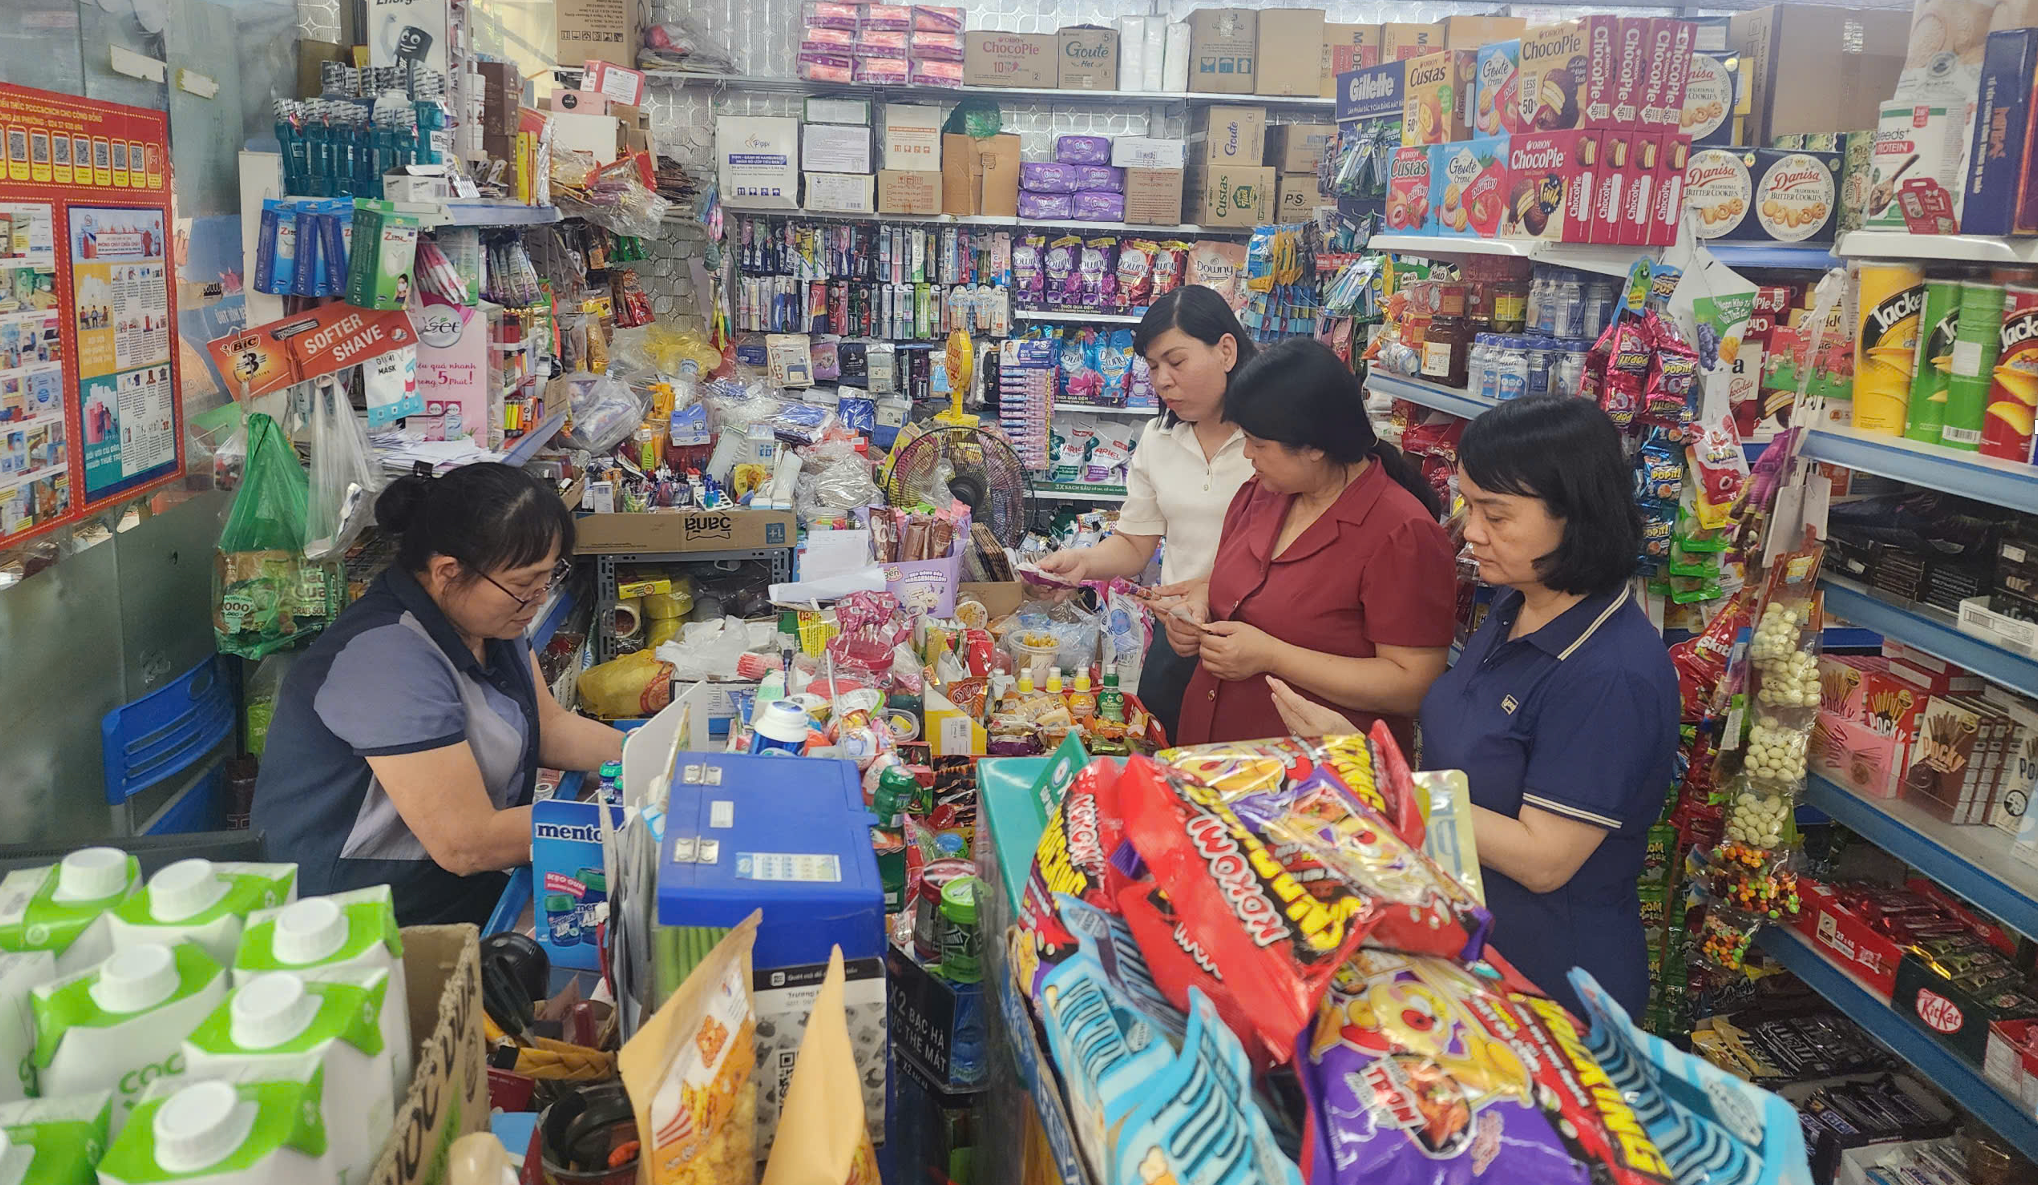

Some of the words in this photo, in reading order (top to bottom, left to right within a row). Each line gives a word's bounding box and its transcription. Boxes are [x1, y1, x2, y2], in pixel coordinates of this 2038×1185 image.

[983, 41, 1040, 55] ChocoPie
[1523, 34, 1580, 61] ChocoPie
[1591, 26, 1609, 99] ChocoPie
[1618, 28, 1640, 101] ChocoPie
[1410, 66, 1447, 88] Custas
[1646, 30, 1671, 102] ChocoPie
[1349, 72, 1394, 102] Gillette
[1391, 157, 1428, 178] Custas
[1511, 147, 1564, 170] ChocoPie
[1686, 163, 1738, 188] Danisa
[1215, 175, 1229, 218] Custas
[1569, 176, 1582, 217] ChocoPie
[1770, 167, 1822, 191] Danisa
[1599, 177, 1612, 219] ChocoPie
[1627, 179, 1640, 220] ChocoPie
[1657, 180, 1671, 221] ChocoPie
[1197, 260, 1234, 275] Downy
[304, 313, 364, 355] SOFTER
[333, 324, 385, 362] SHAVE
[2000, 315, 2038, 351] Jack
[1868, 709, 1907, 743] POCKY
[1922, 735, 1966, 774] POCKY
[537, 824, 603, 842] mento
[1186, 812, 1291, 948] KOKOMI
[1921, 996, 1960, 1030] KitKat
